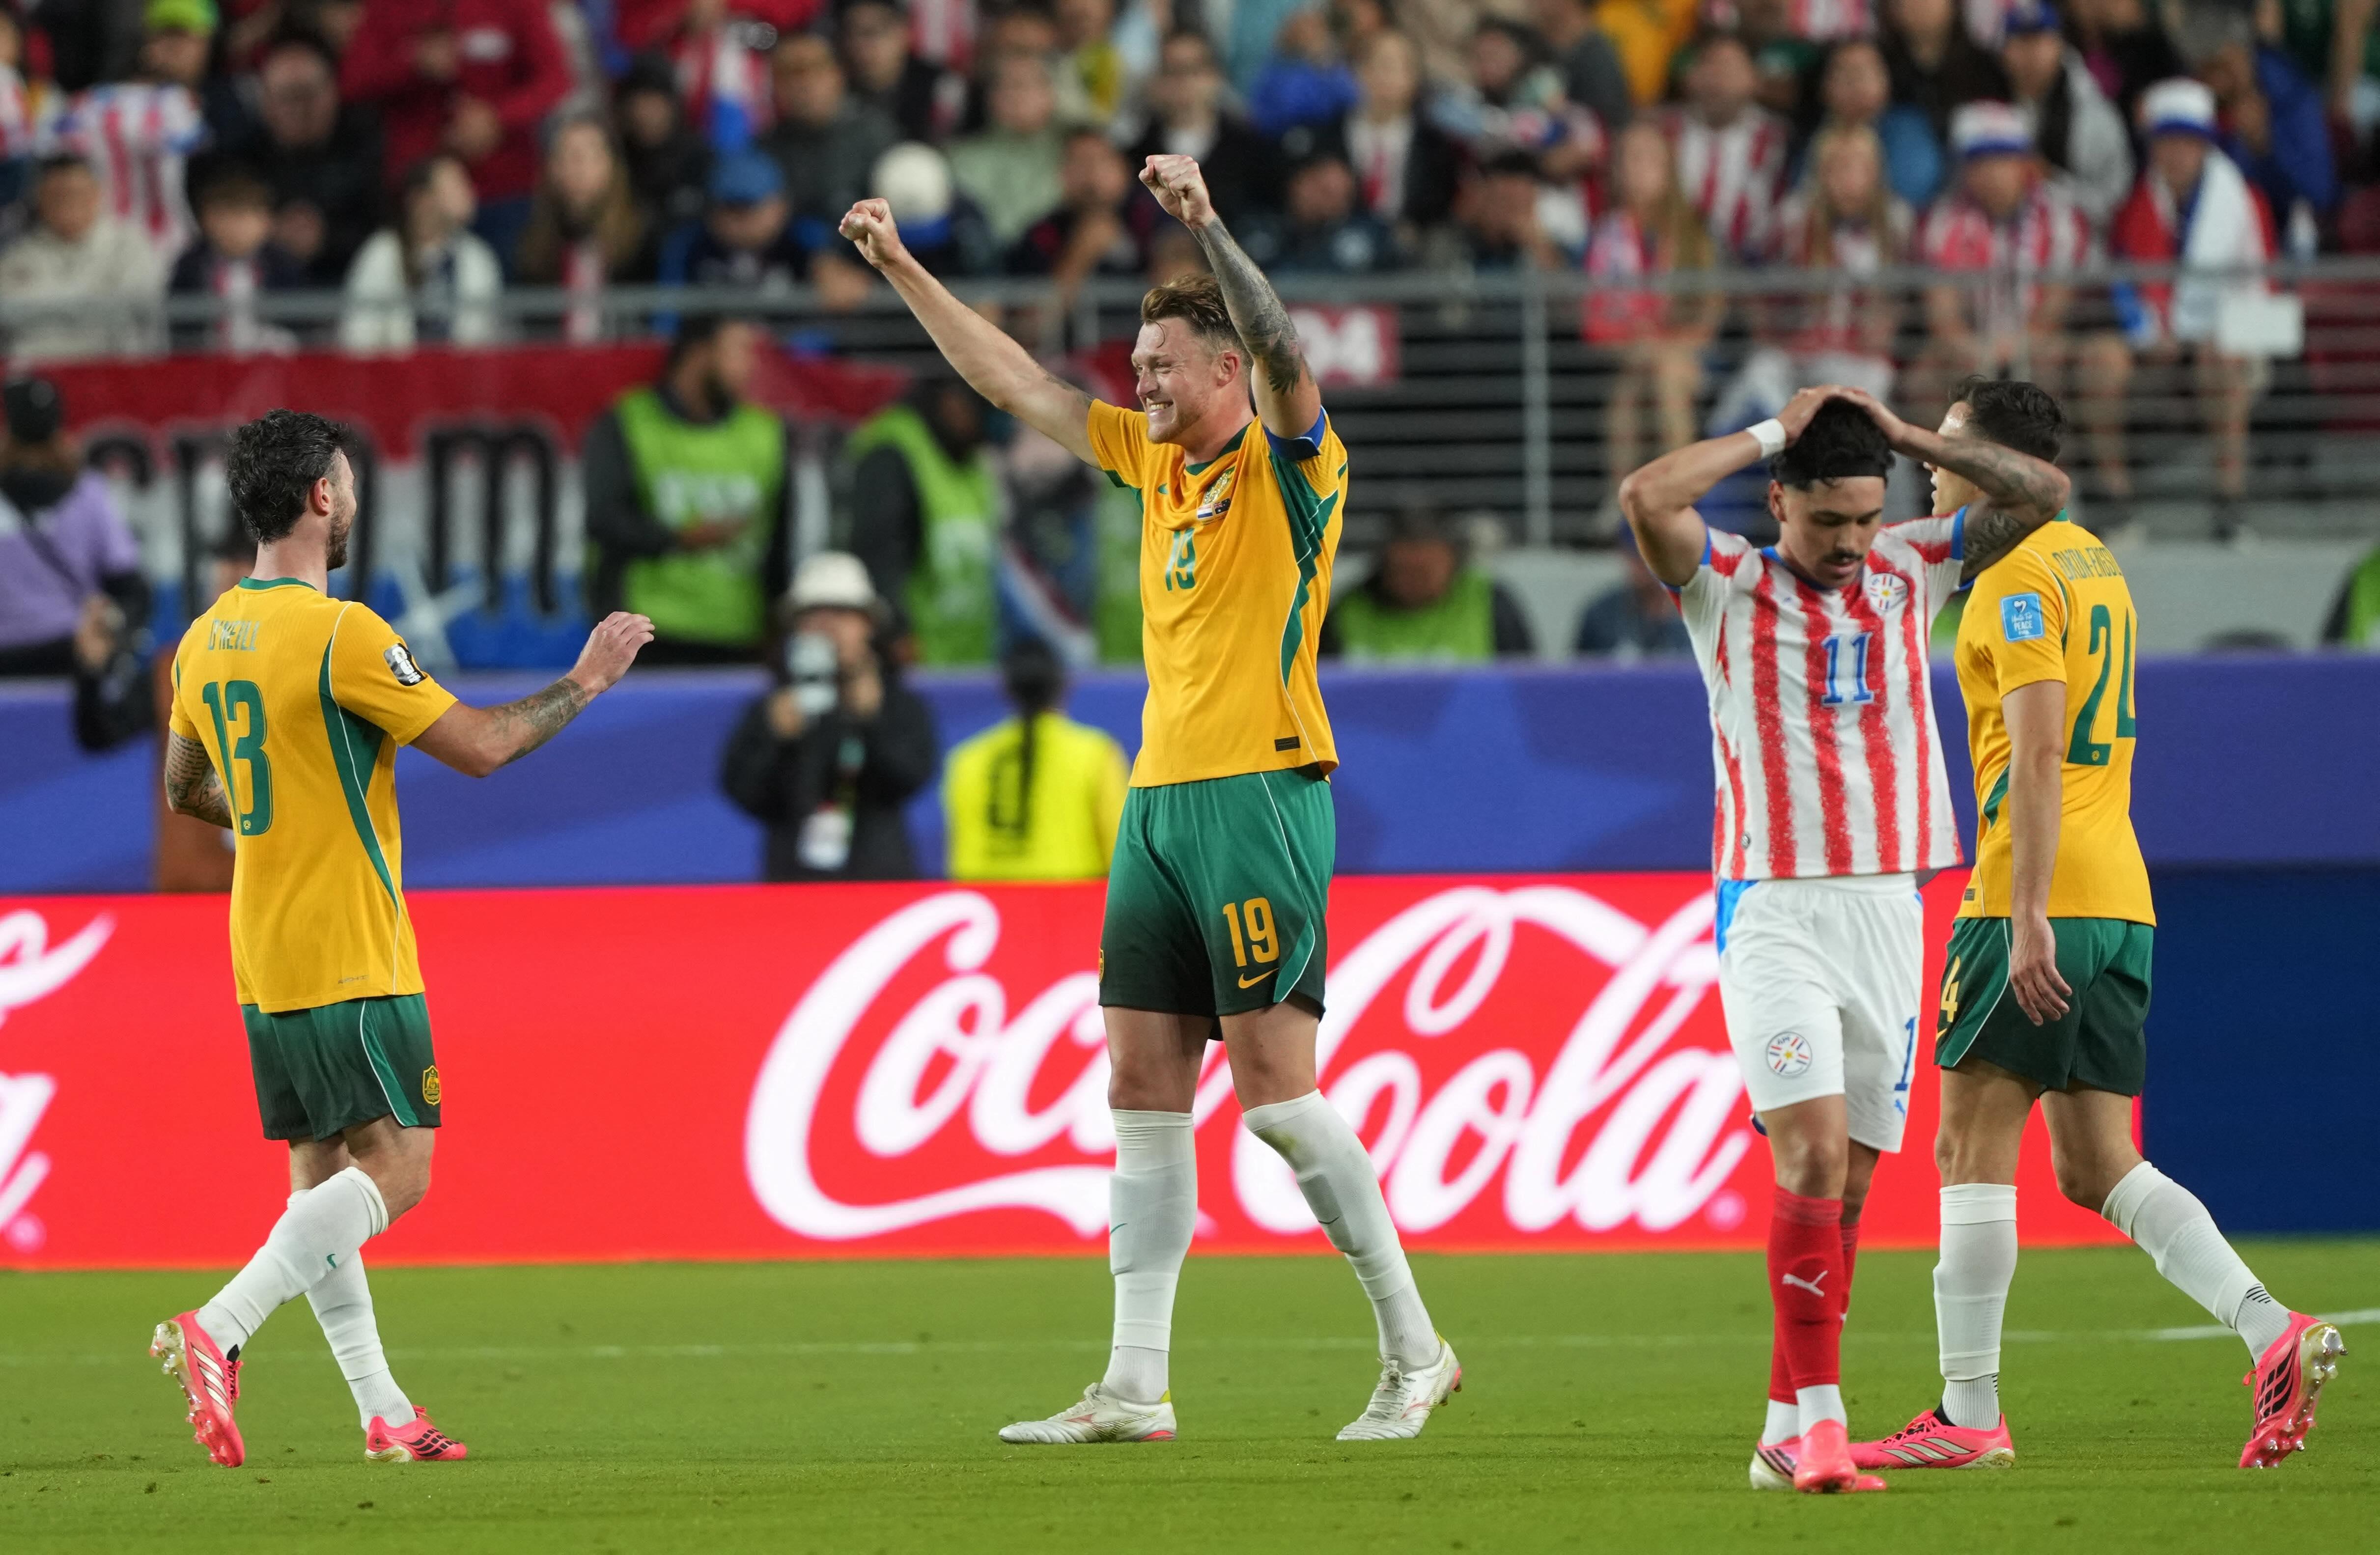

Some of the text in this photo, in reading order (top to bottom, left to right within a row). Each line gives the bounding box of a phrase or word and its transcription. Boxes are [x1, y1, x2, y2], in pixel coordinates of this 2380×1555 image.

[1165, 527, 1196, 591] 19
[208, 619, 260, 651] O'NEILL
[1821, 632, 1875, 706] 11
[202, 680, 273, 836] 13
[1223, 897, 1280, 967] 19
[1940, 955, 1961, 1023] 4
